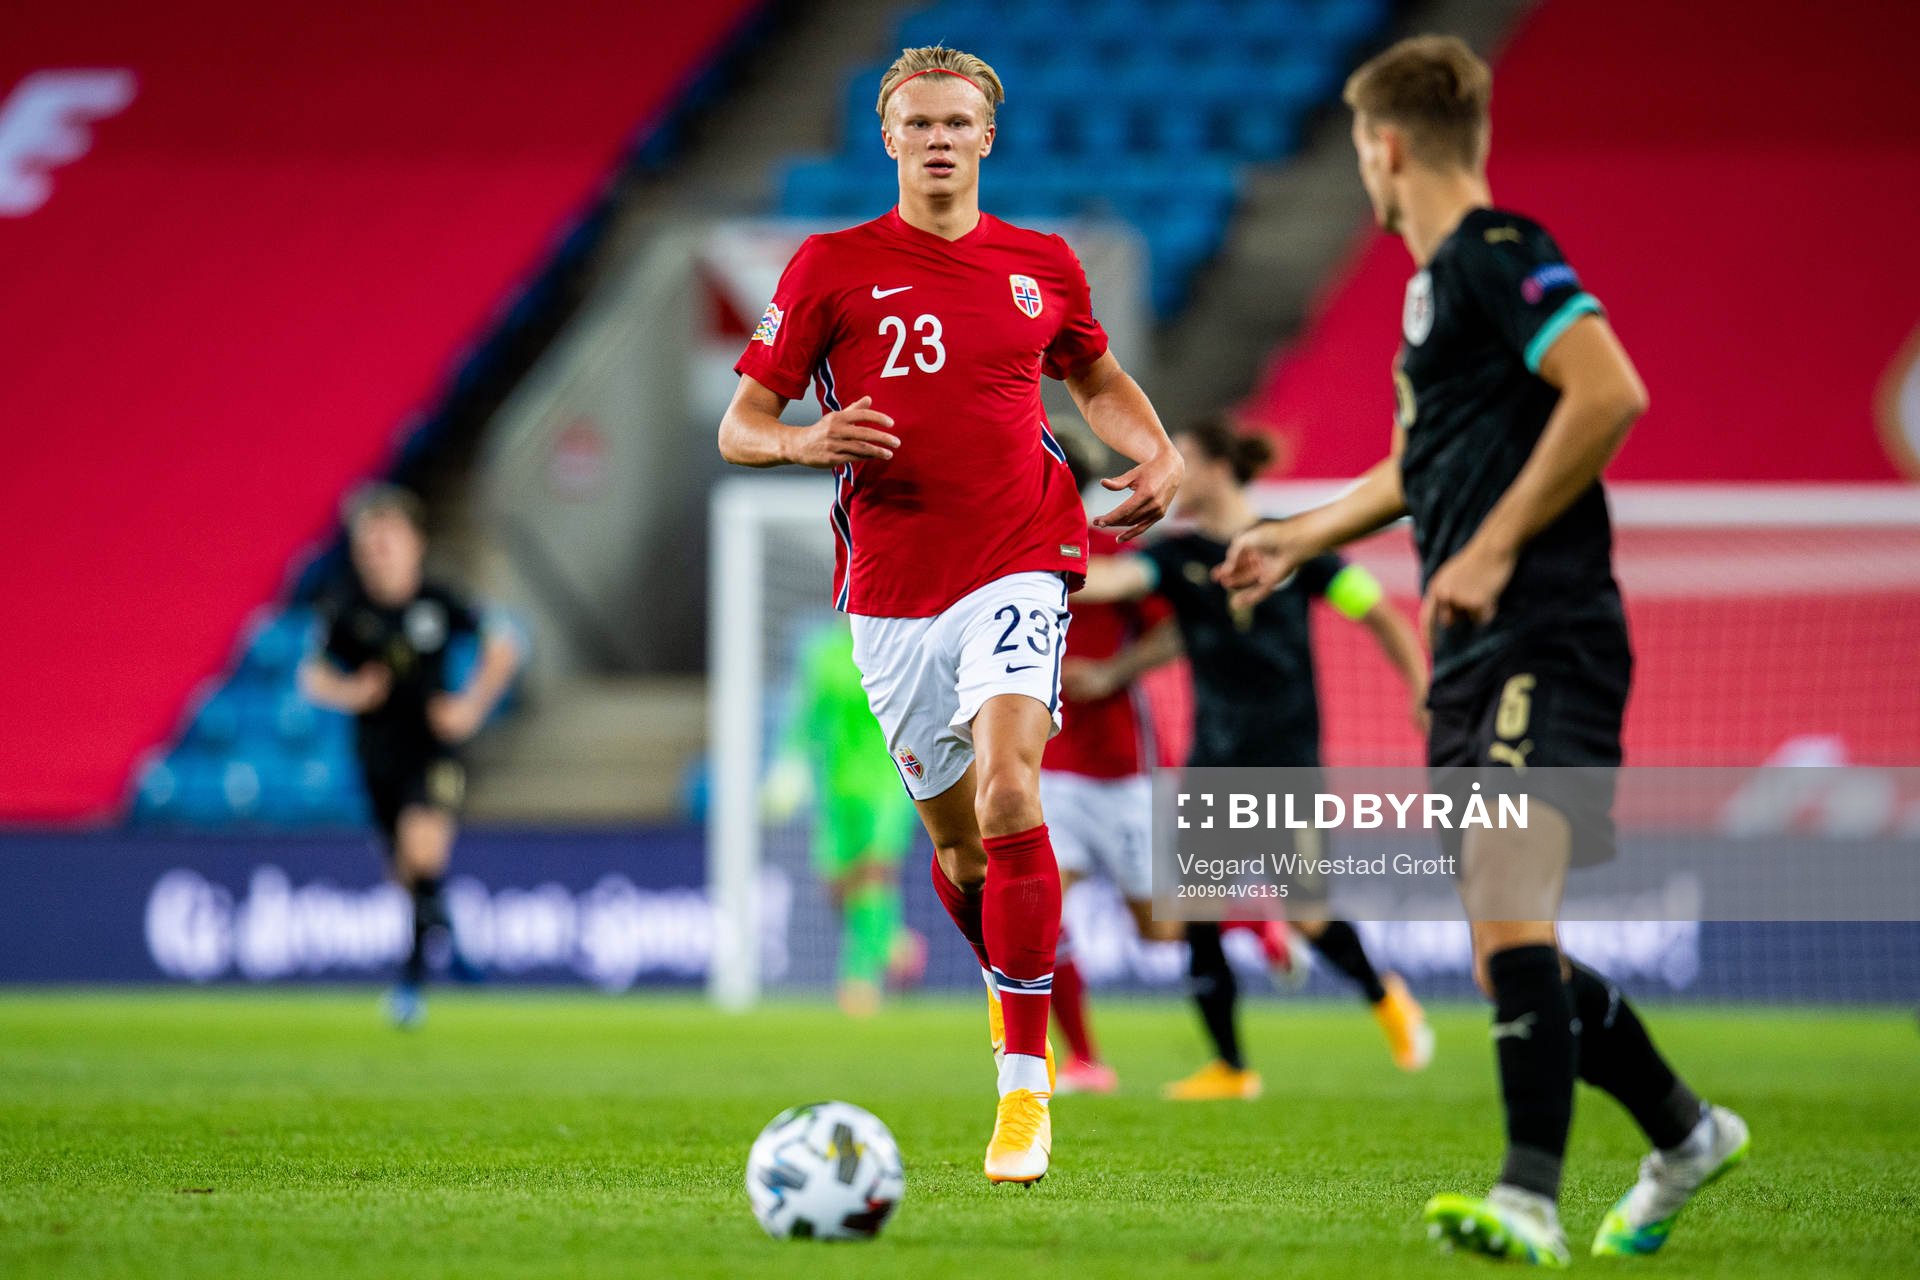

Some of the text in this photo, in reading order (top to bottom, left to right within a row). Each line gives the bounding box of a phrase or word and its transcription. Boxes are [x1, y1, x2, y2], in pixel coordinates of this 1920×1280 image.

[878, 313, 946, 378] 23
[992, 604, 1051, 656] 23
[1495, 673, 1536, 740] 6
